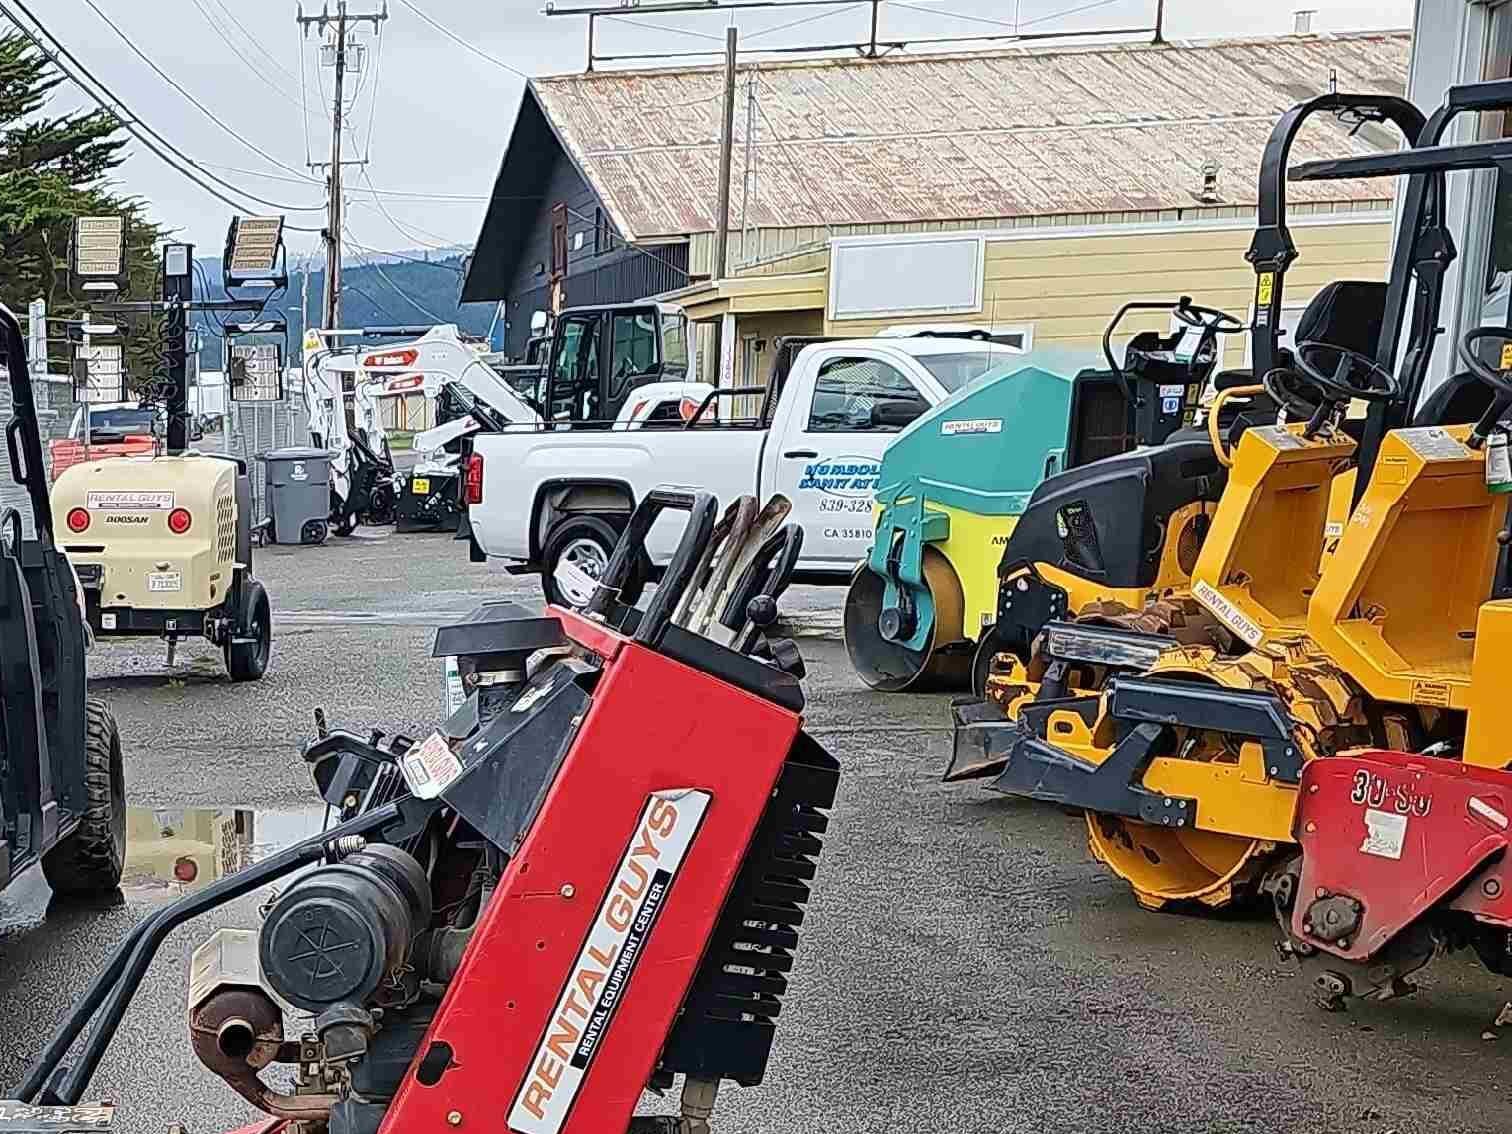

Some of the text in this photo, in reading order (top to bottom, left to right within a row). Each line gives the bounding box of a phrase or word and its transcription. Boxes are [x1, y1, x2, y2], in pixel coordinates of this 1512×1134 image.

[105, 515, 150, 524] DOOSAN
[823, 528, 839, 538] CA
[1199, 584, 1259, 641] RENTAL GUYS
[520, 798, 679, 1121] RENTAL GUYS
[578, 882, 665, 1057] RENTAL EQUIPMENT CENTER
